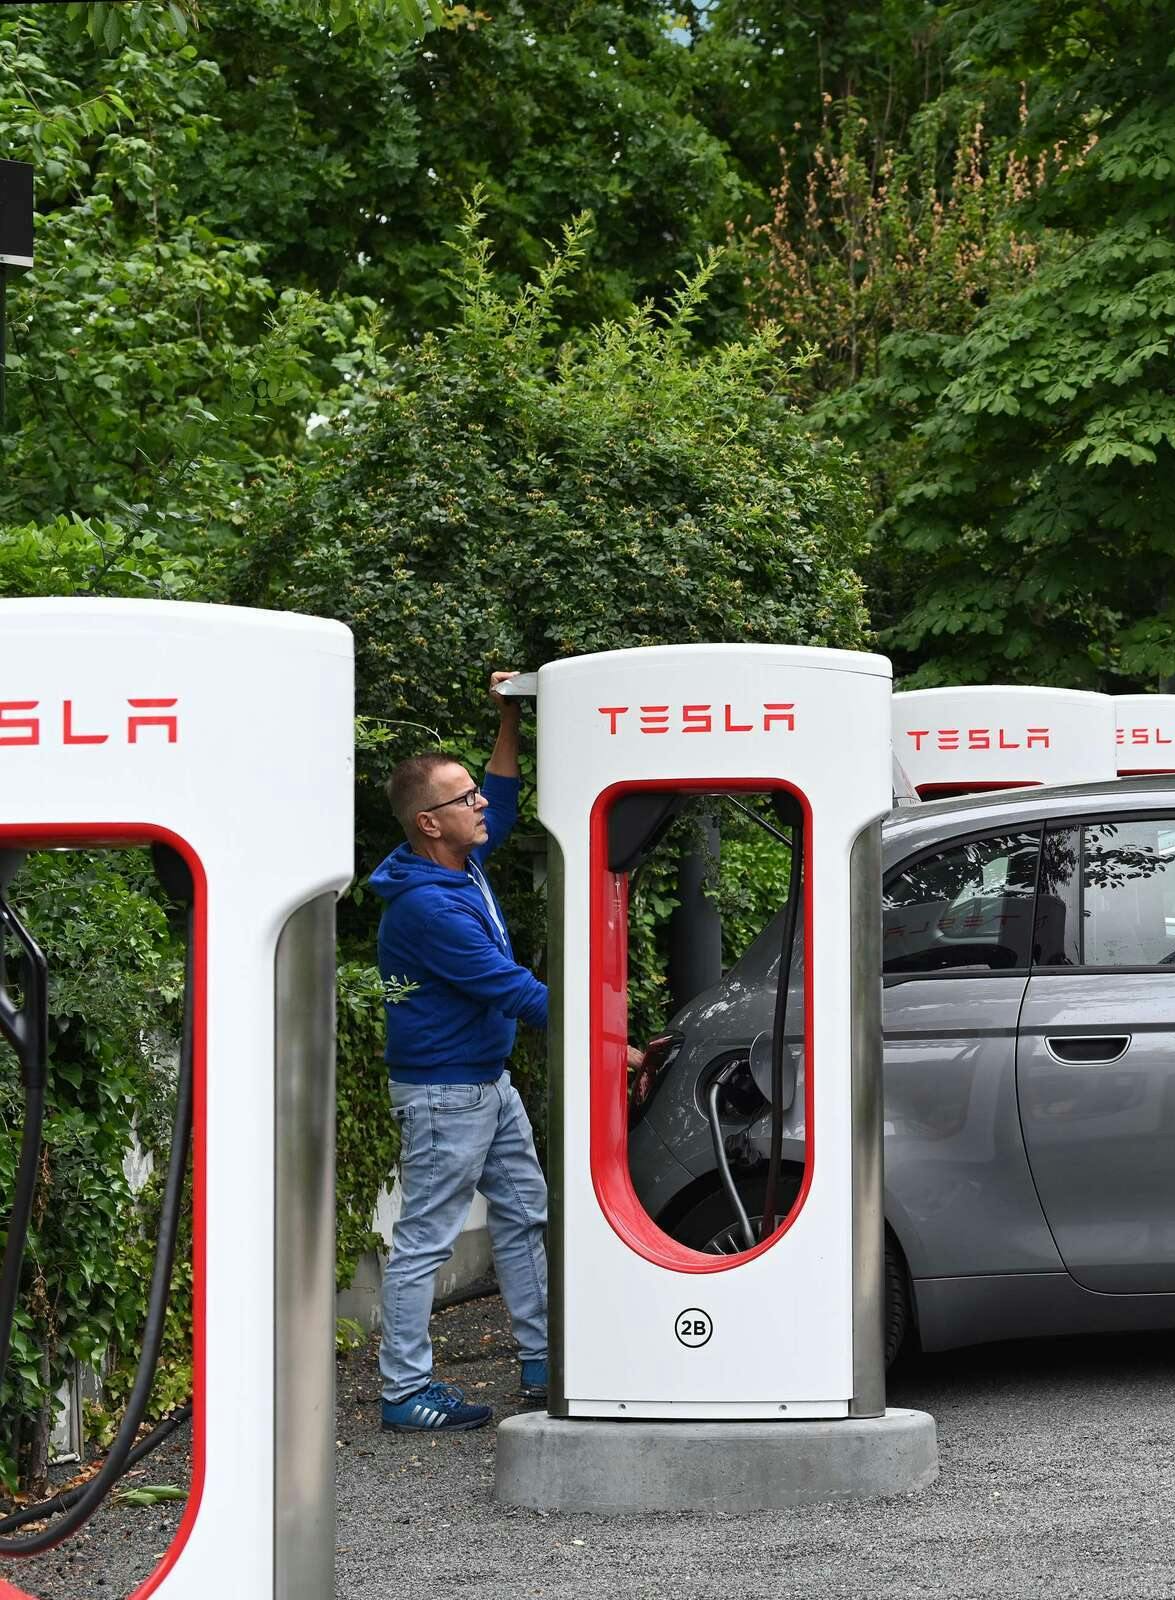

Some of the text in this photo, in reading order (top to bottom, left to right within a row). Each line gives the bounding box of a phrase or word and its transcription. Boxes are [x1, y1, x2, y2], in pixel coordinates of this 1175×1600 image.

[598, 703, 796, 735] TESLA
[906, 728, 1051, 751] TESLA
[681, 1320, 706, 1336] 2B
